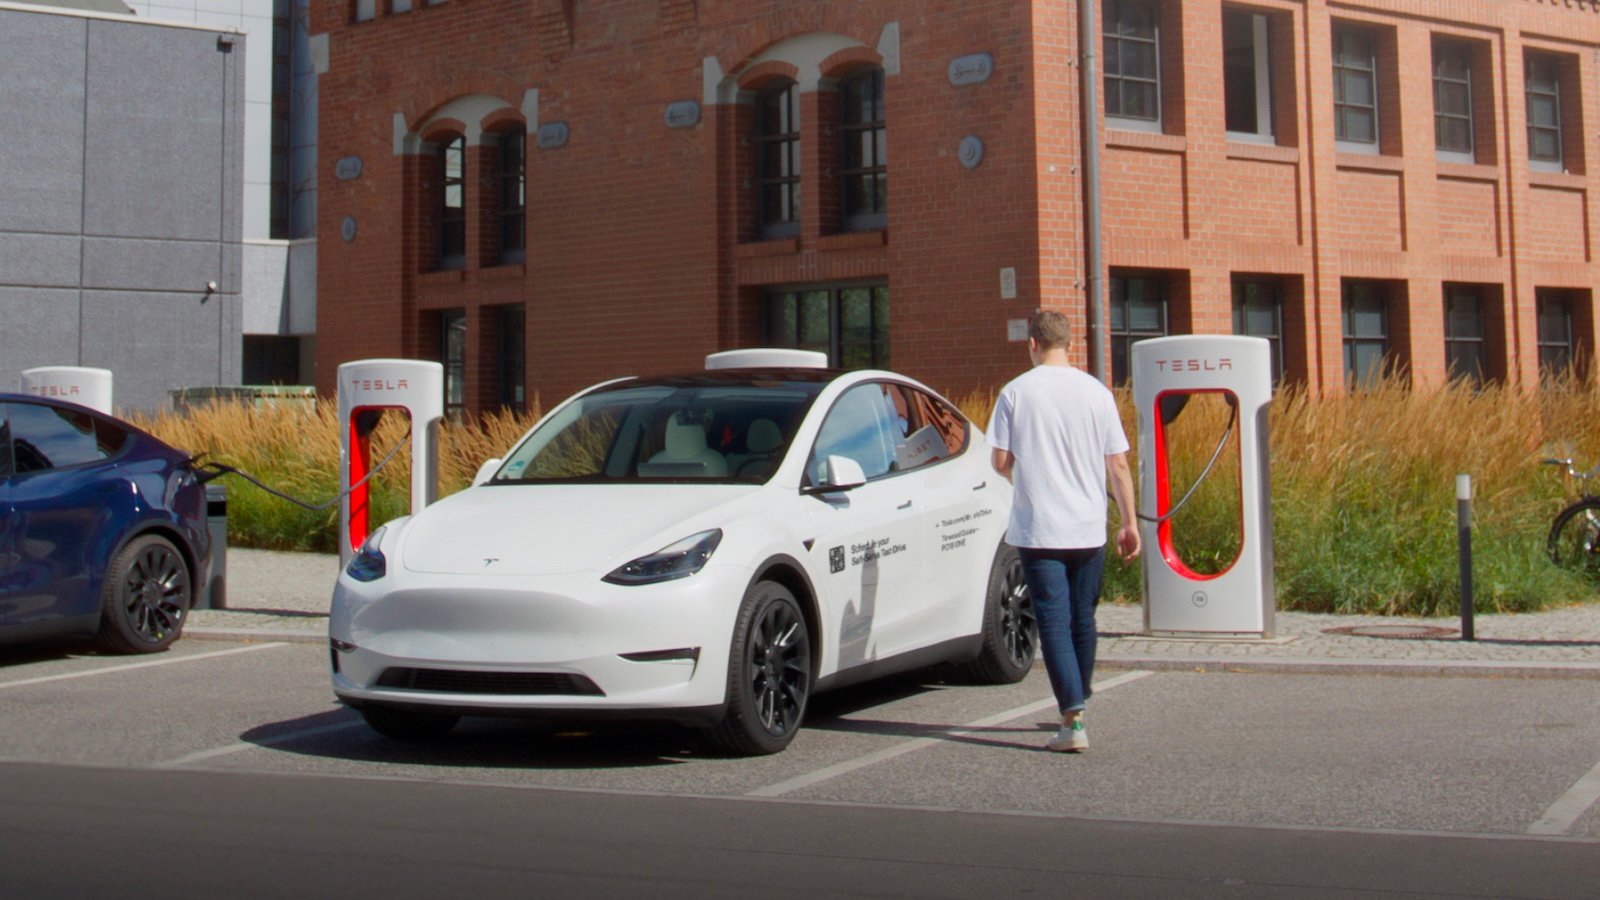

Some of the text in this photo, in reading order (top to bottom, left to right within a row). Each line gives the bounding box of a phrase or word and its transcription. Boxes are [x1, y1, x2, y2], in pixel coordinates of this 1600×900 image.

[1155, 358, 1232, 372] TESLA
[31, 385, 80, 396] TESLA
[351, 379, 409, 391] TESLA
[877, 537, 890, 549] your
[892, 543, 907, 554] Drive
